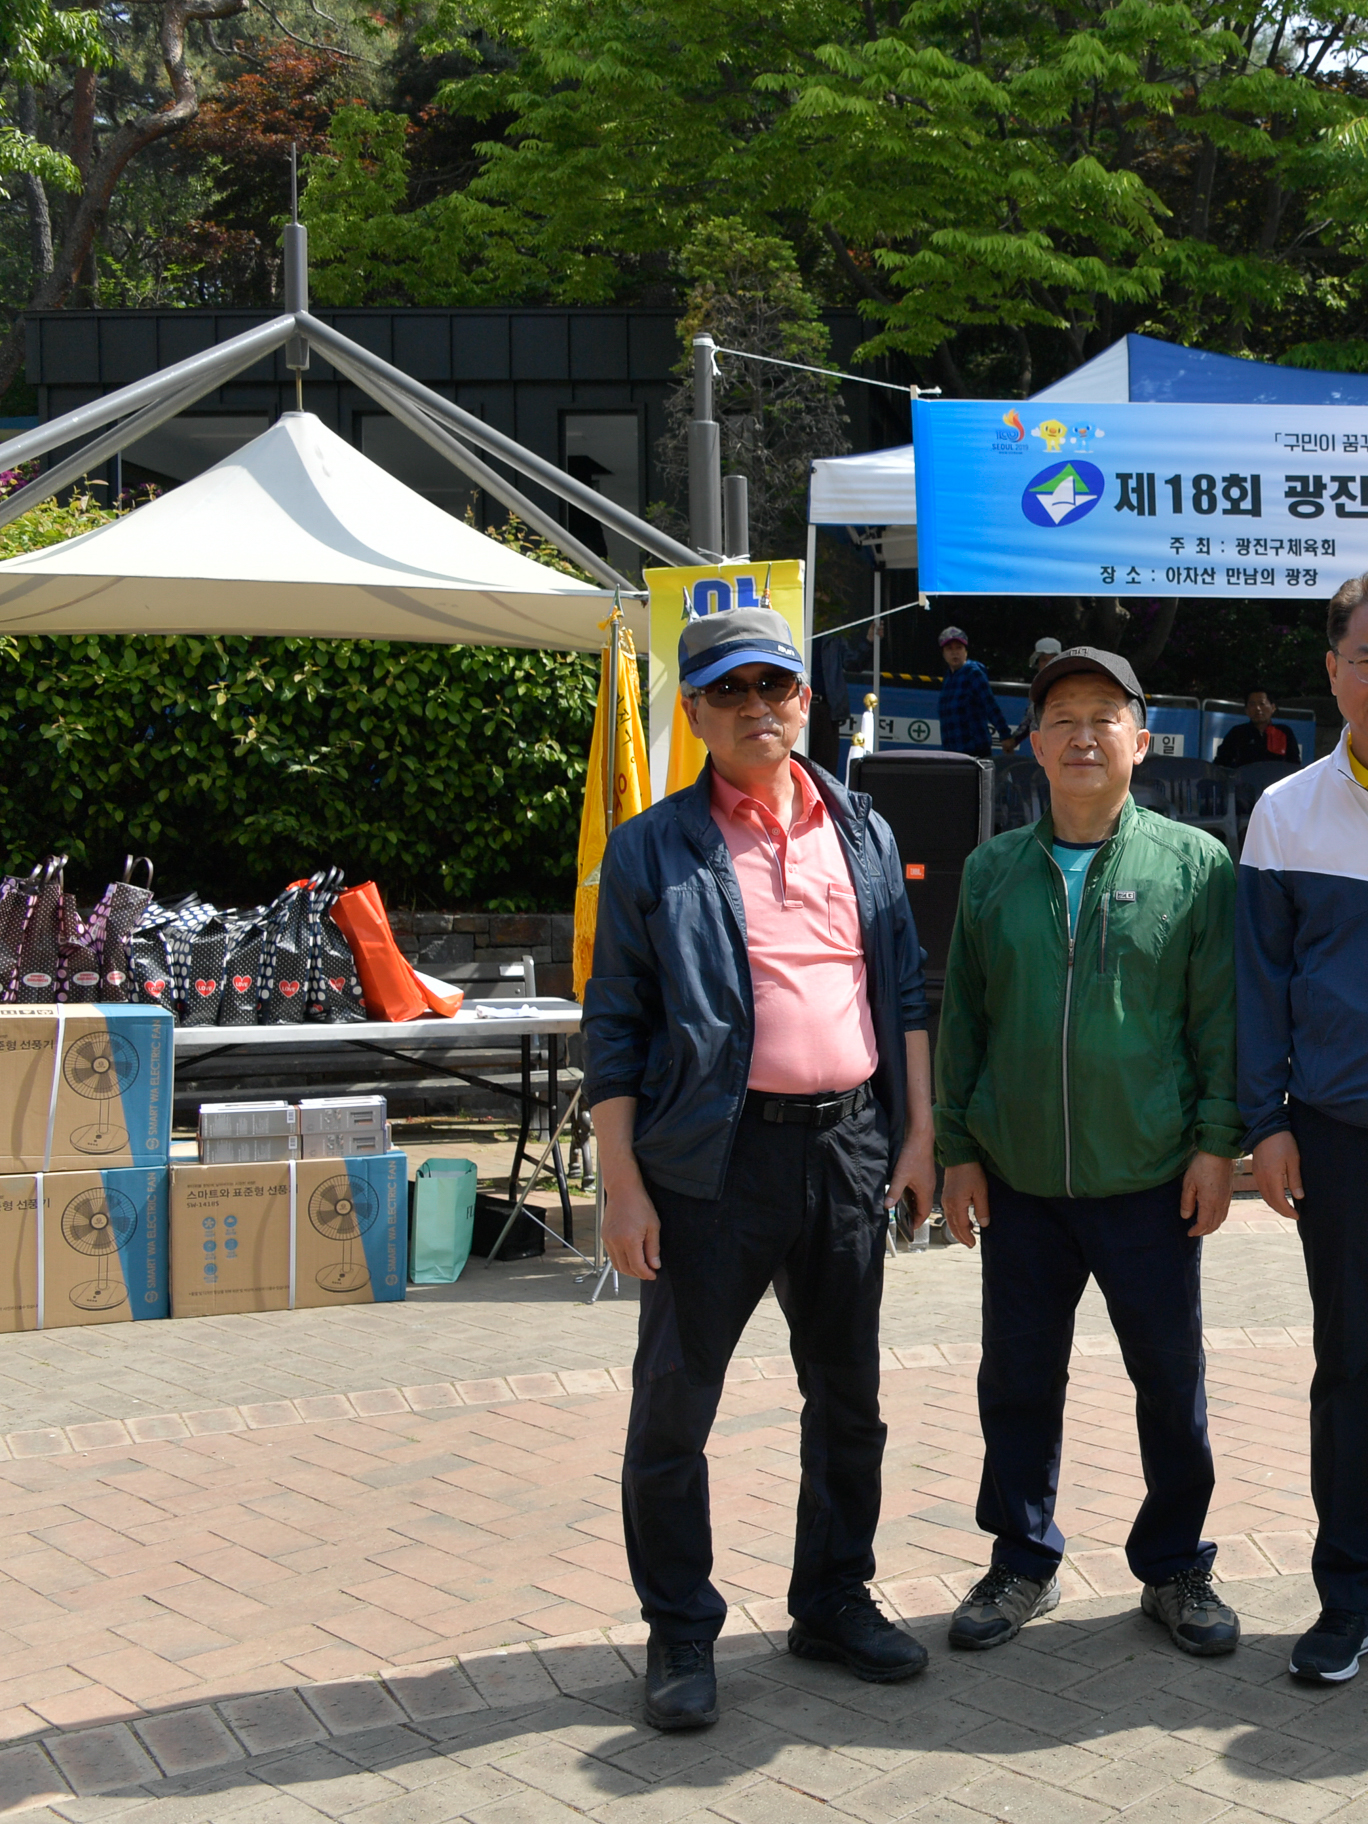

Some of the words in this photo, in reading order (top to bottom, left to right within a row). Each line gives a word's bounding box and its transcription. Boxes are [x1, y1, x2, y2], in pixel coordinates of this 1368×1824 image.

[992, 443, 1013, 451] SEOUL
[1114, 472, 1262, 518] 제18회
[1235, 538, 1336, 557] 광진구체육회
[1165, 566, 1216, 586] 아차산
[1226, 567, 1275, 586] 만남의
[1285, 568, 1319, 587] 광장
[152, 1019, 161, 1039] FAN
[20, 1039, 54, 1050] 선풍기
[150, 1042, 161, 1085] ELECTRIC
[150, 1088, 159, 1102] WA
[148, 1105, 158, 1135] SMART
[388, 1160, 397, 1180] FAN
[147, 1172, 156, 1192] FAN
[186, 1188, 230, 1200] 스마트와
[232, 1186, 264, 1197] 표준형
[387, 1182, 397, 1224] ELECTRIC
[147, 1195, 157, 1238] ELECTRIC
[388, 1226, 396, 1240] WA
[147, 1241, 156, 1256] WA
[387, 1243, 396, 1272] SMART
[147, 1258, 156, 1288] SMART
